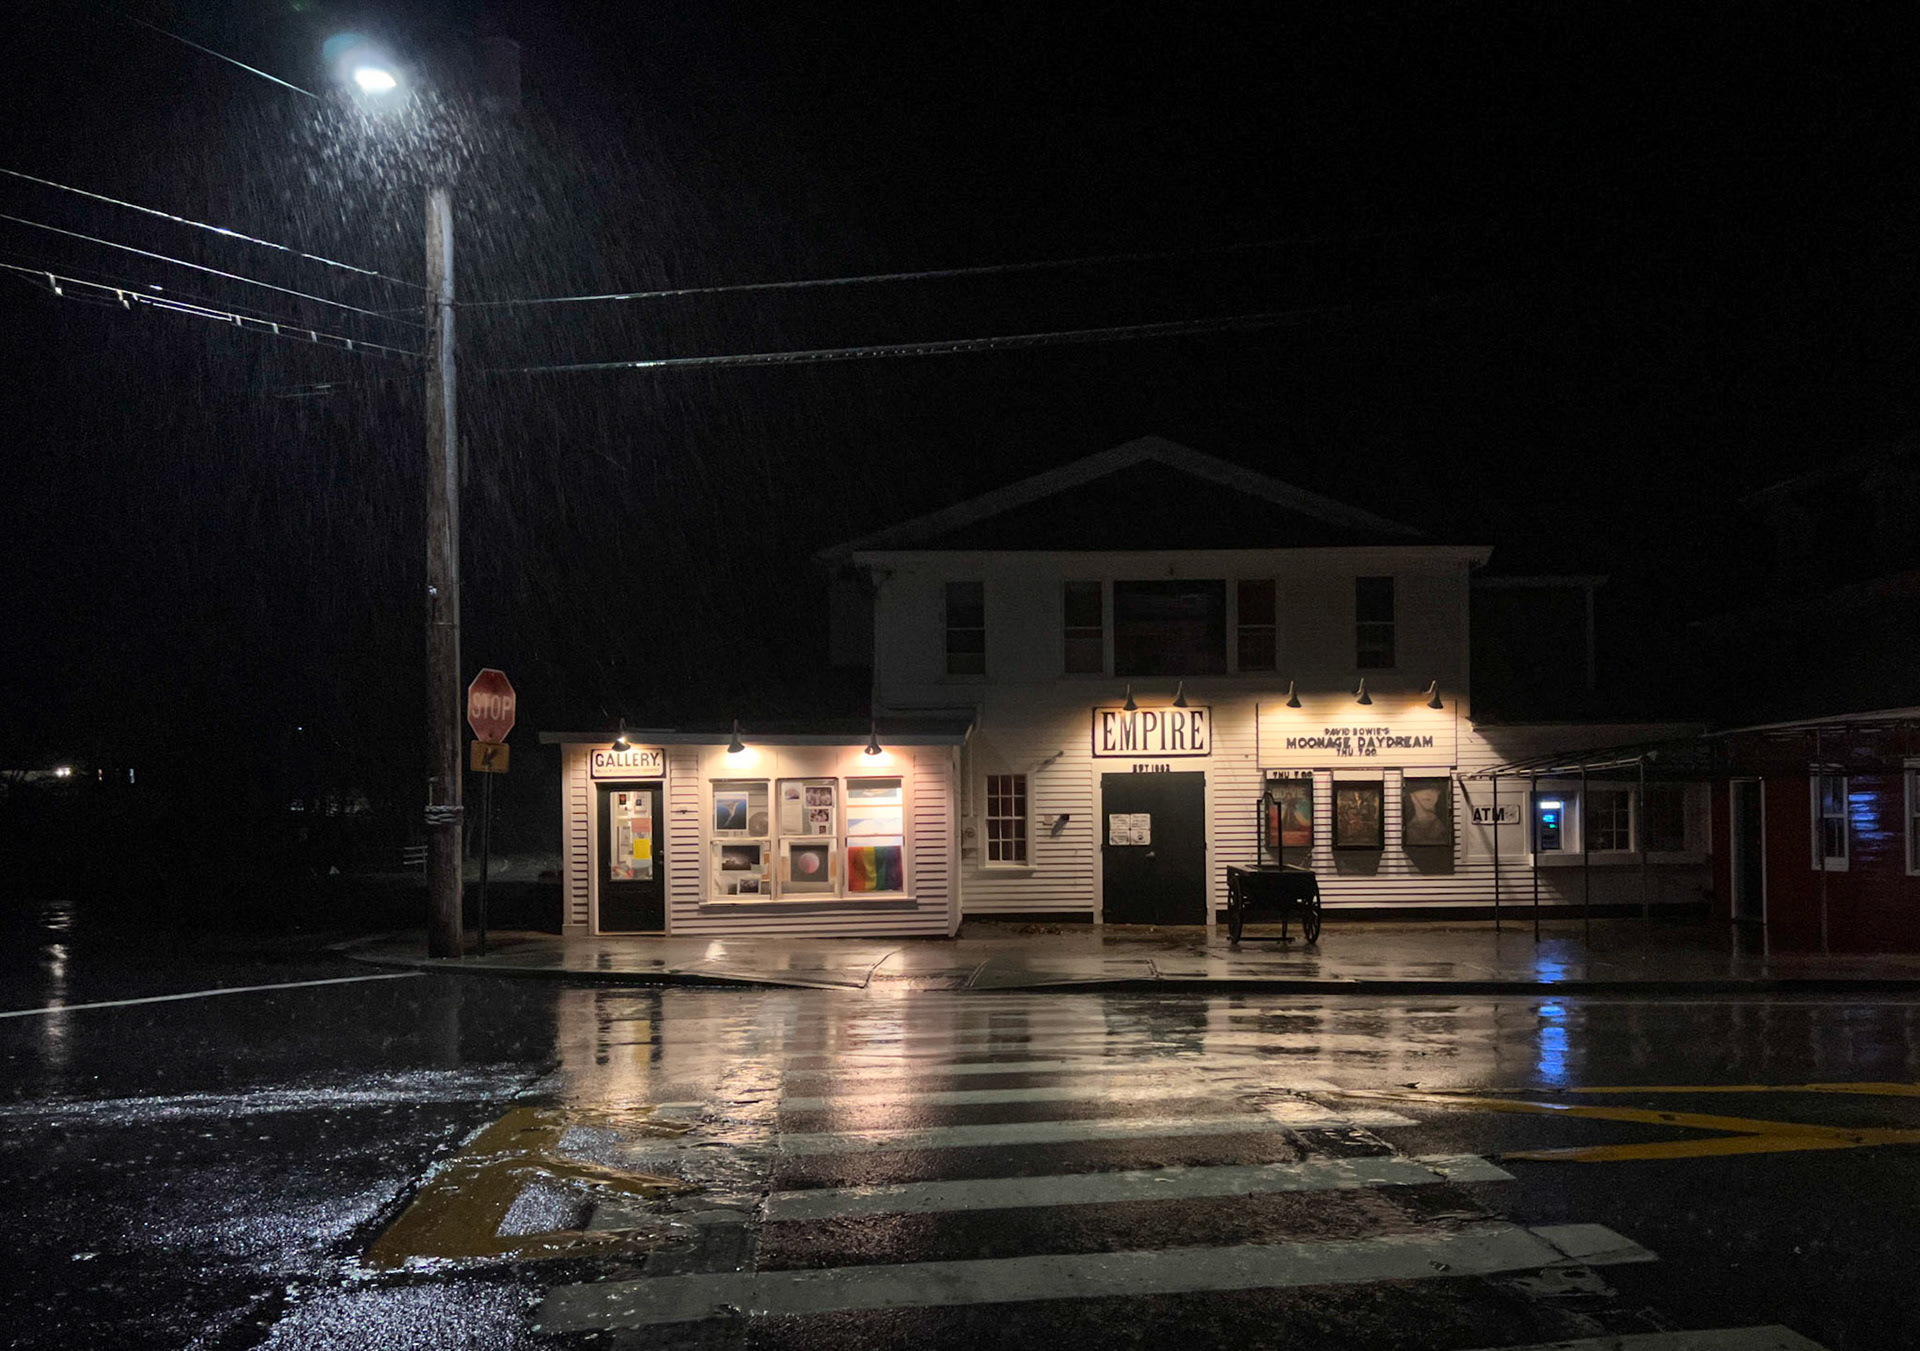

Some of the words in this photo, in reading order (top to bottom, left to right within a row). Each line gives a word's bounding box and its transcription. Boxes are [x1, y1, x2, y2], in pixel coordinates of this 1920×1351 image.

[471, 692, 512, 721] STOP
[1102, 710, 1204, 751] EMPIRE
[1324, 727, 1350, 736] DAVID
[1353, 727, 1390, 736] BOWIE'S
[1286, 736, 1351, 749] MOONAGE
[1358, 735, 1433, 749] DAYDREAM
[1336, 748, 1354, 757] THU
[1472, 807, 1505, 822] ATM
